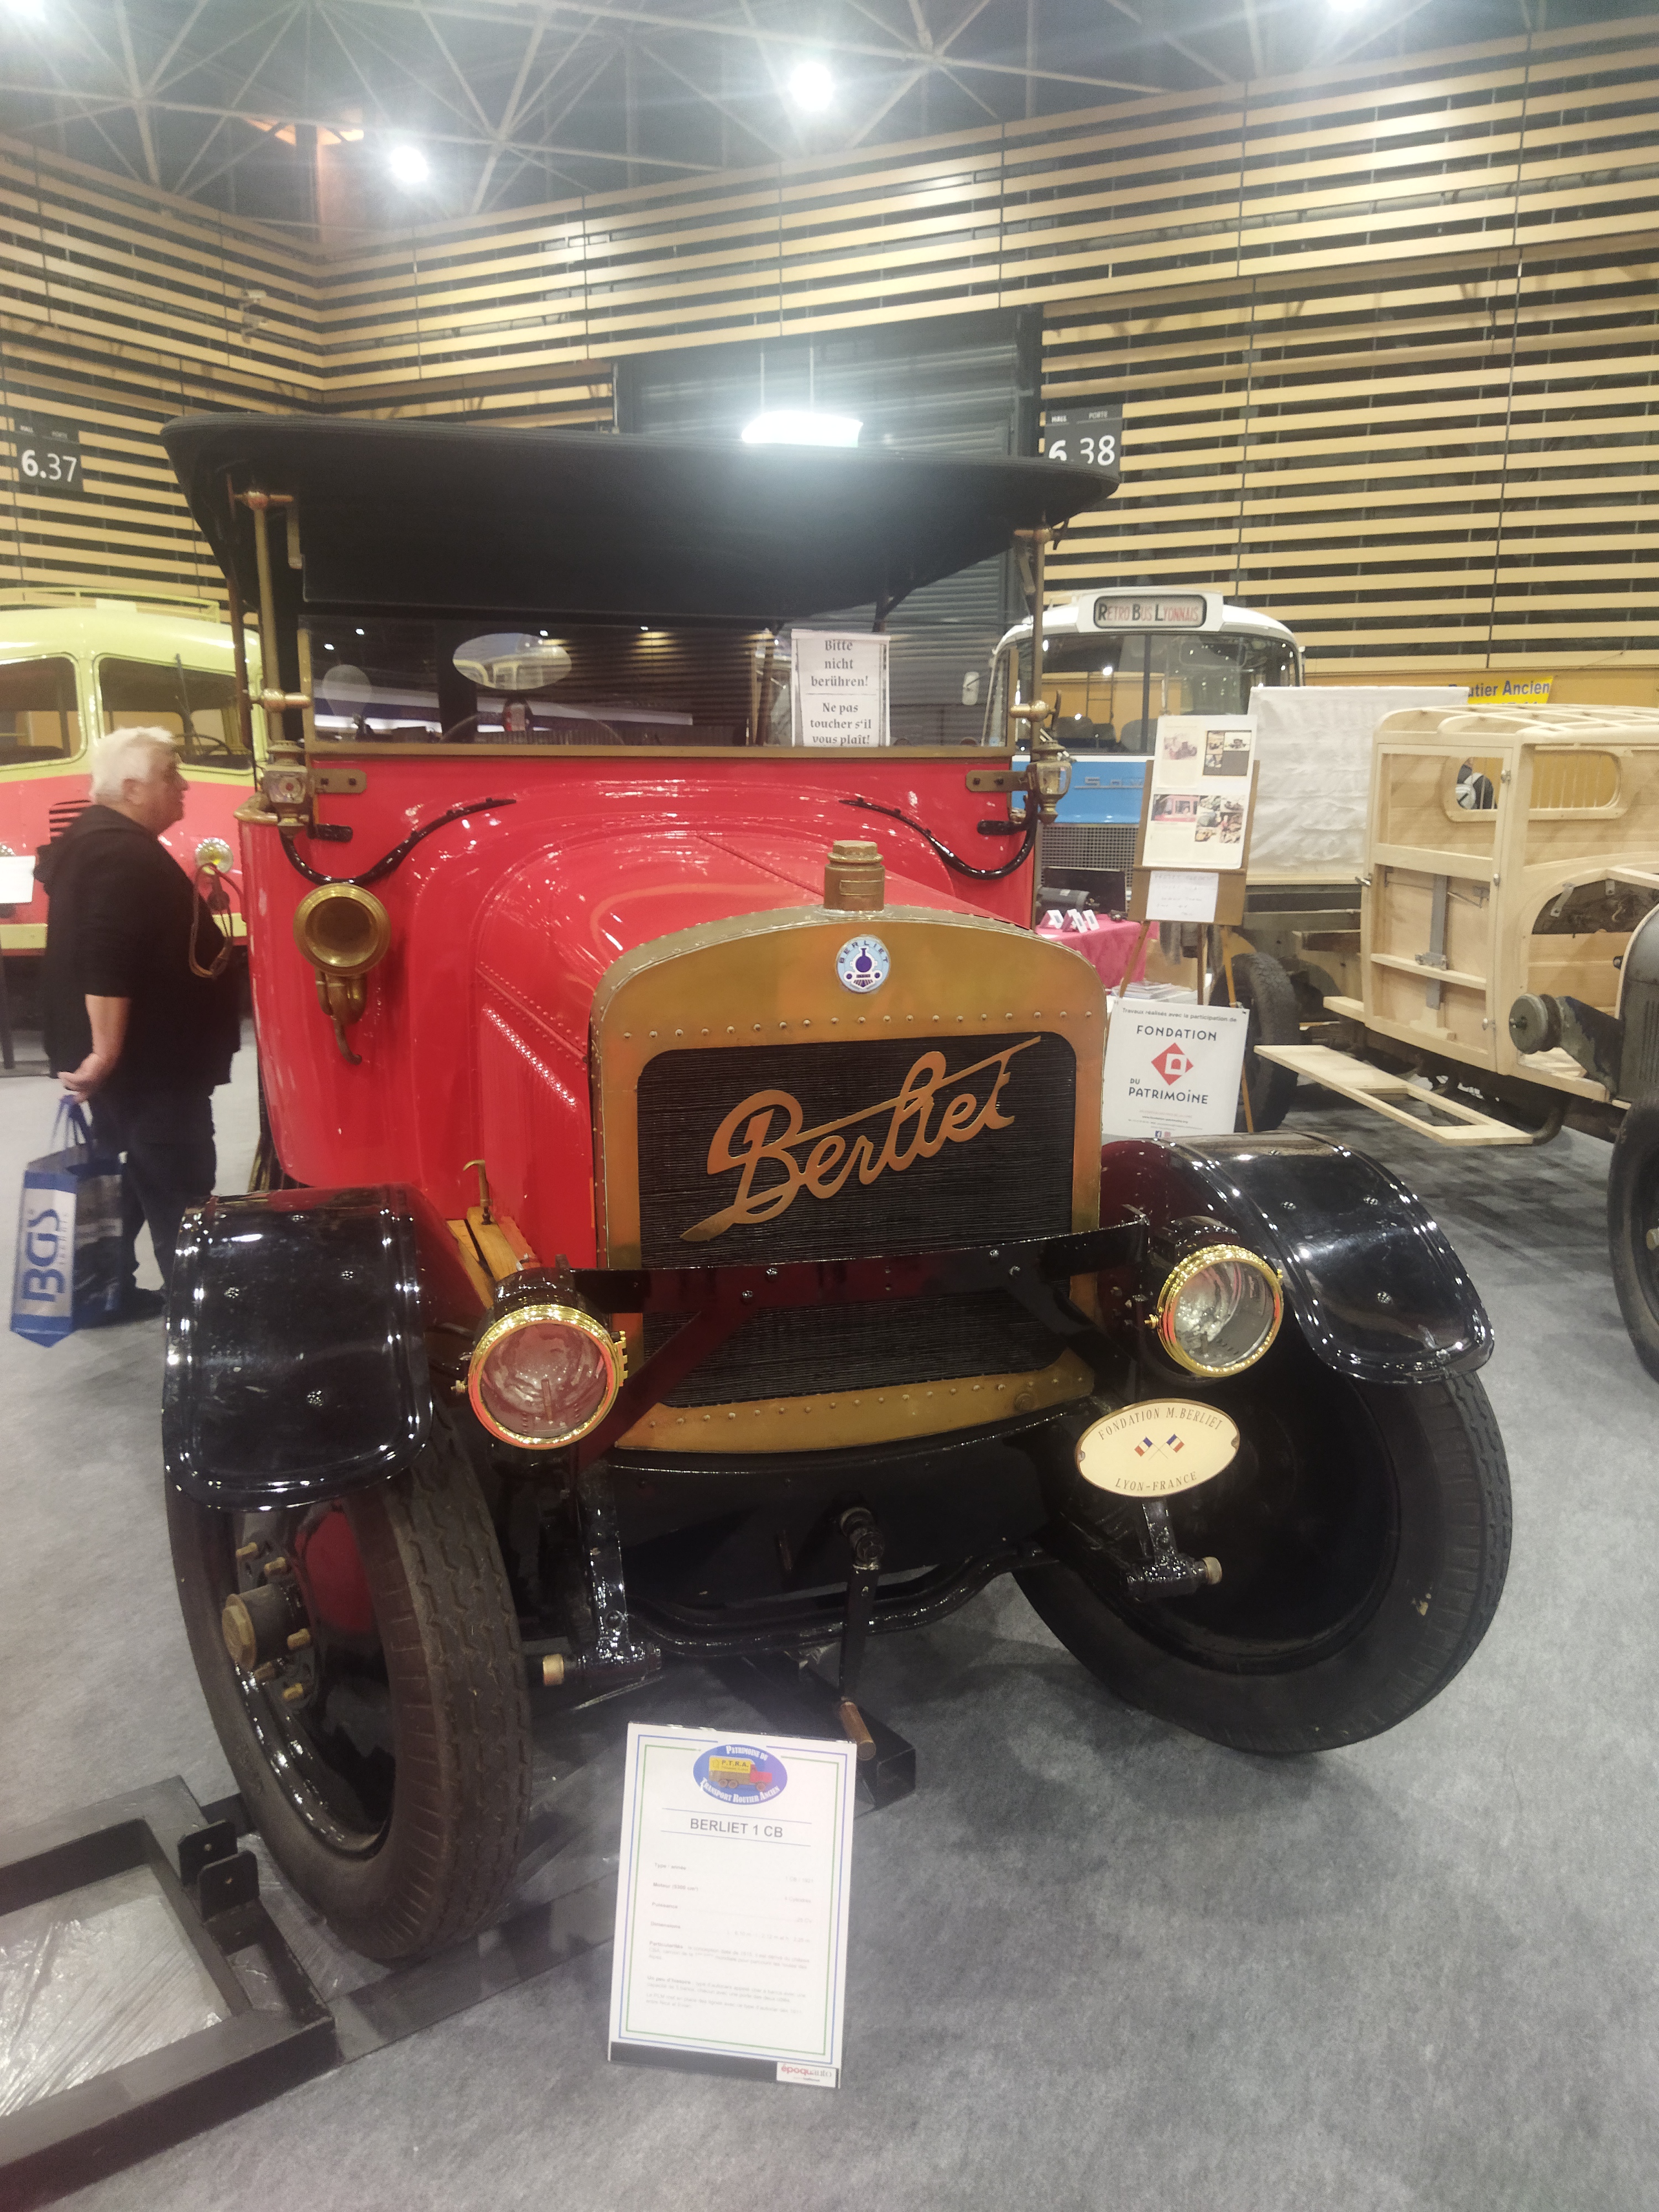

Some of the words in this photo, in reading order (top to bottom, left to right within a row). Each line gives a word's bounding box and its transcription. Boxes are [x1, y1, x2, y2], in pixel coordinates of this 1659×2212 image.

[22, 450, 77, 482] 6.37
[825, 640, 853, 651] Bitte
[825, 658, 853, 670] nicht
[811, 676, 869, 687] berühren!
[1503, 680, 1550, 696] Ancien
[822, 702, 836, 712] Ne
[839, 704, 859, 714] pas
[810, 720, 852, 729] toucher
[812, 736, 837, 744] vous
[839, 940, 888, 964] BERLIET
[1136, 1025, 1218, 1042] FONDATION
[680, 1036, 1041, 1241] Berliet
[1098, 1407, 1160, 1440] FONDATION
[690, 1818, 749, 1835] BERLIET
[753, 1825, 759, 1836] 1
[764, 1825, 783, 1838] CB
